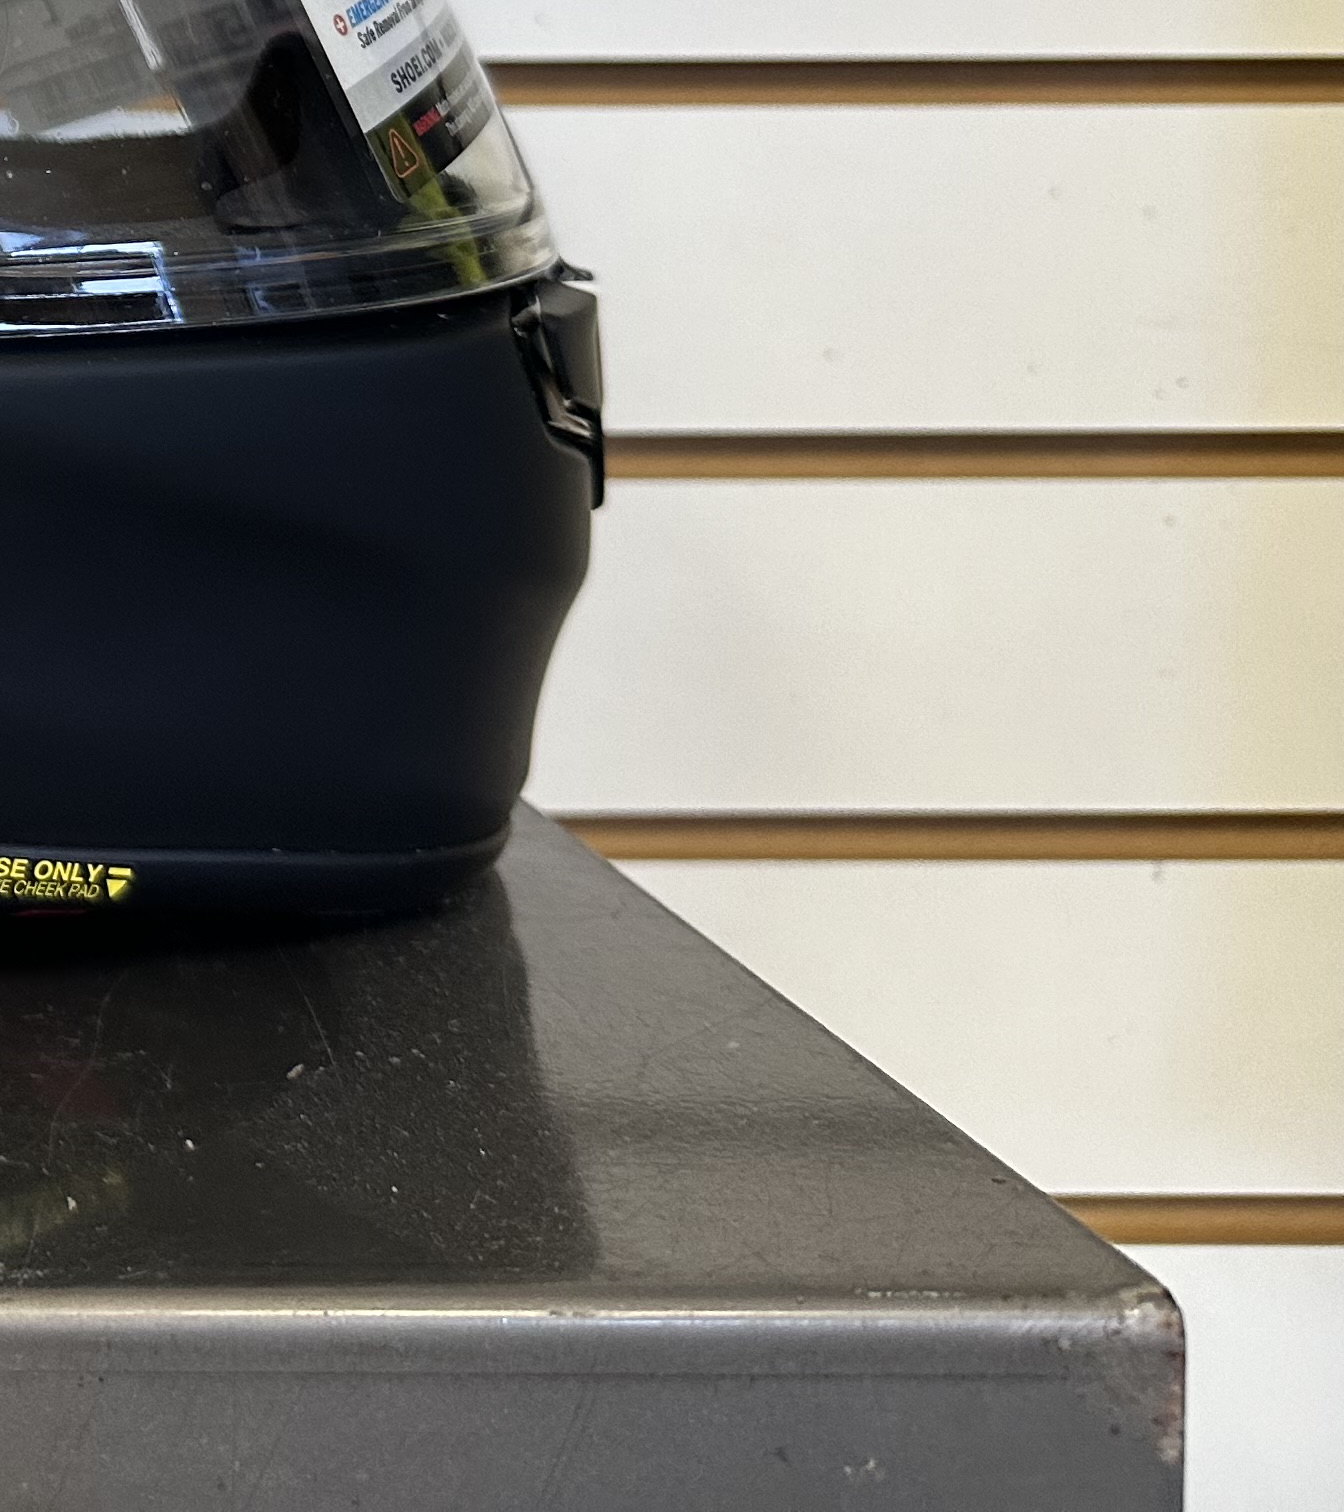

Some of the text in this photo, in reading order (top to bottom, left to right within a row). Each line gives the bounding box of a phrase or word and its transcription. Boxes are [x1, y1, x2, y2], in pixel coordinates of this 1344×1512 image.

[357, 26, 377, 48] Safe
[390, 39, 442, 93] SHOEI.COM
[34, 859, 103, 883] ONLY
[14, 878, 68, 898] CHEEK
[68, 883, 99, 899] PAD
